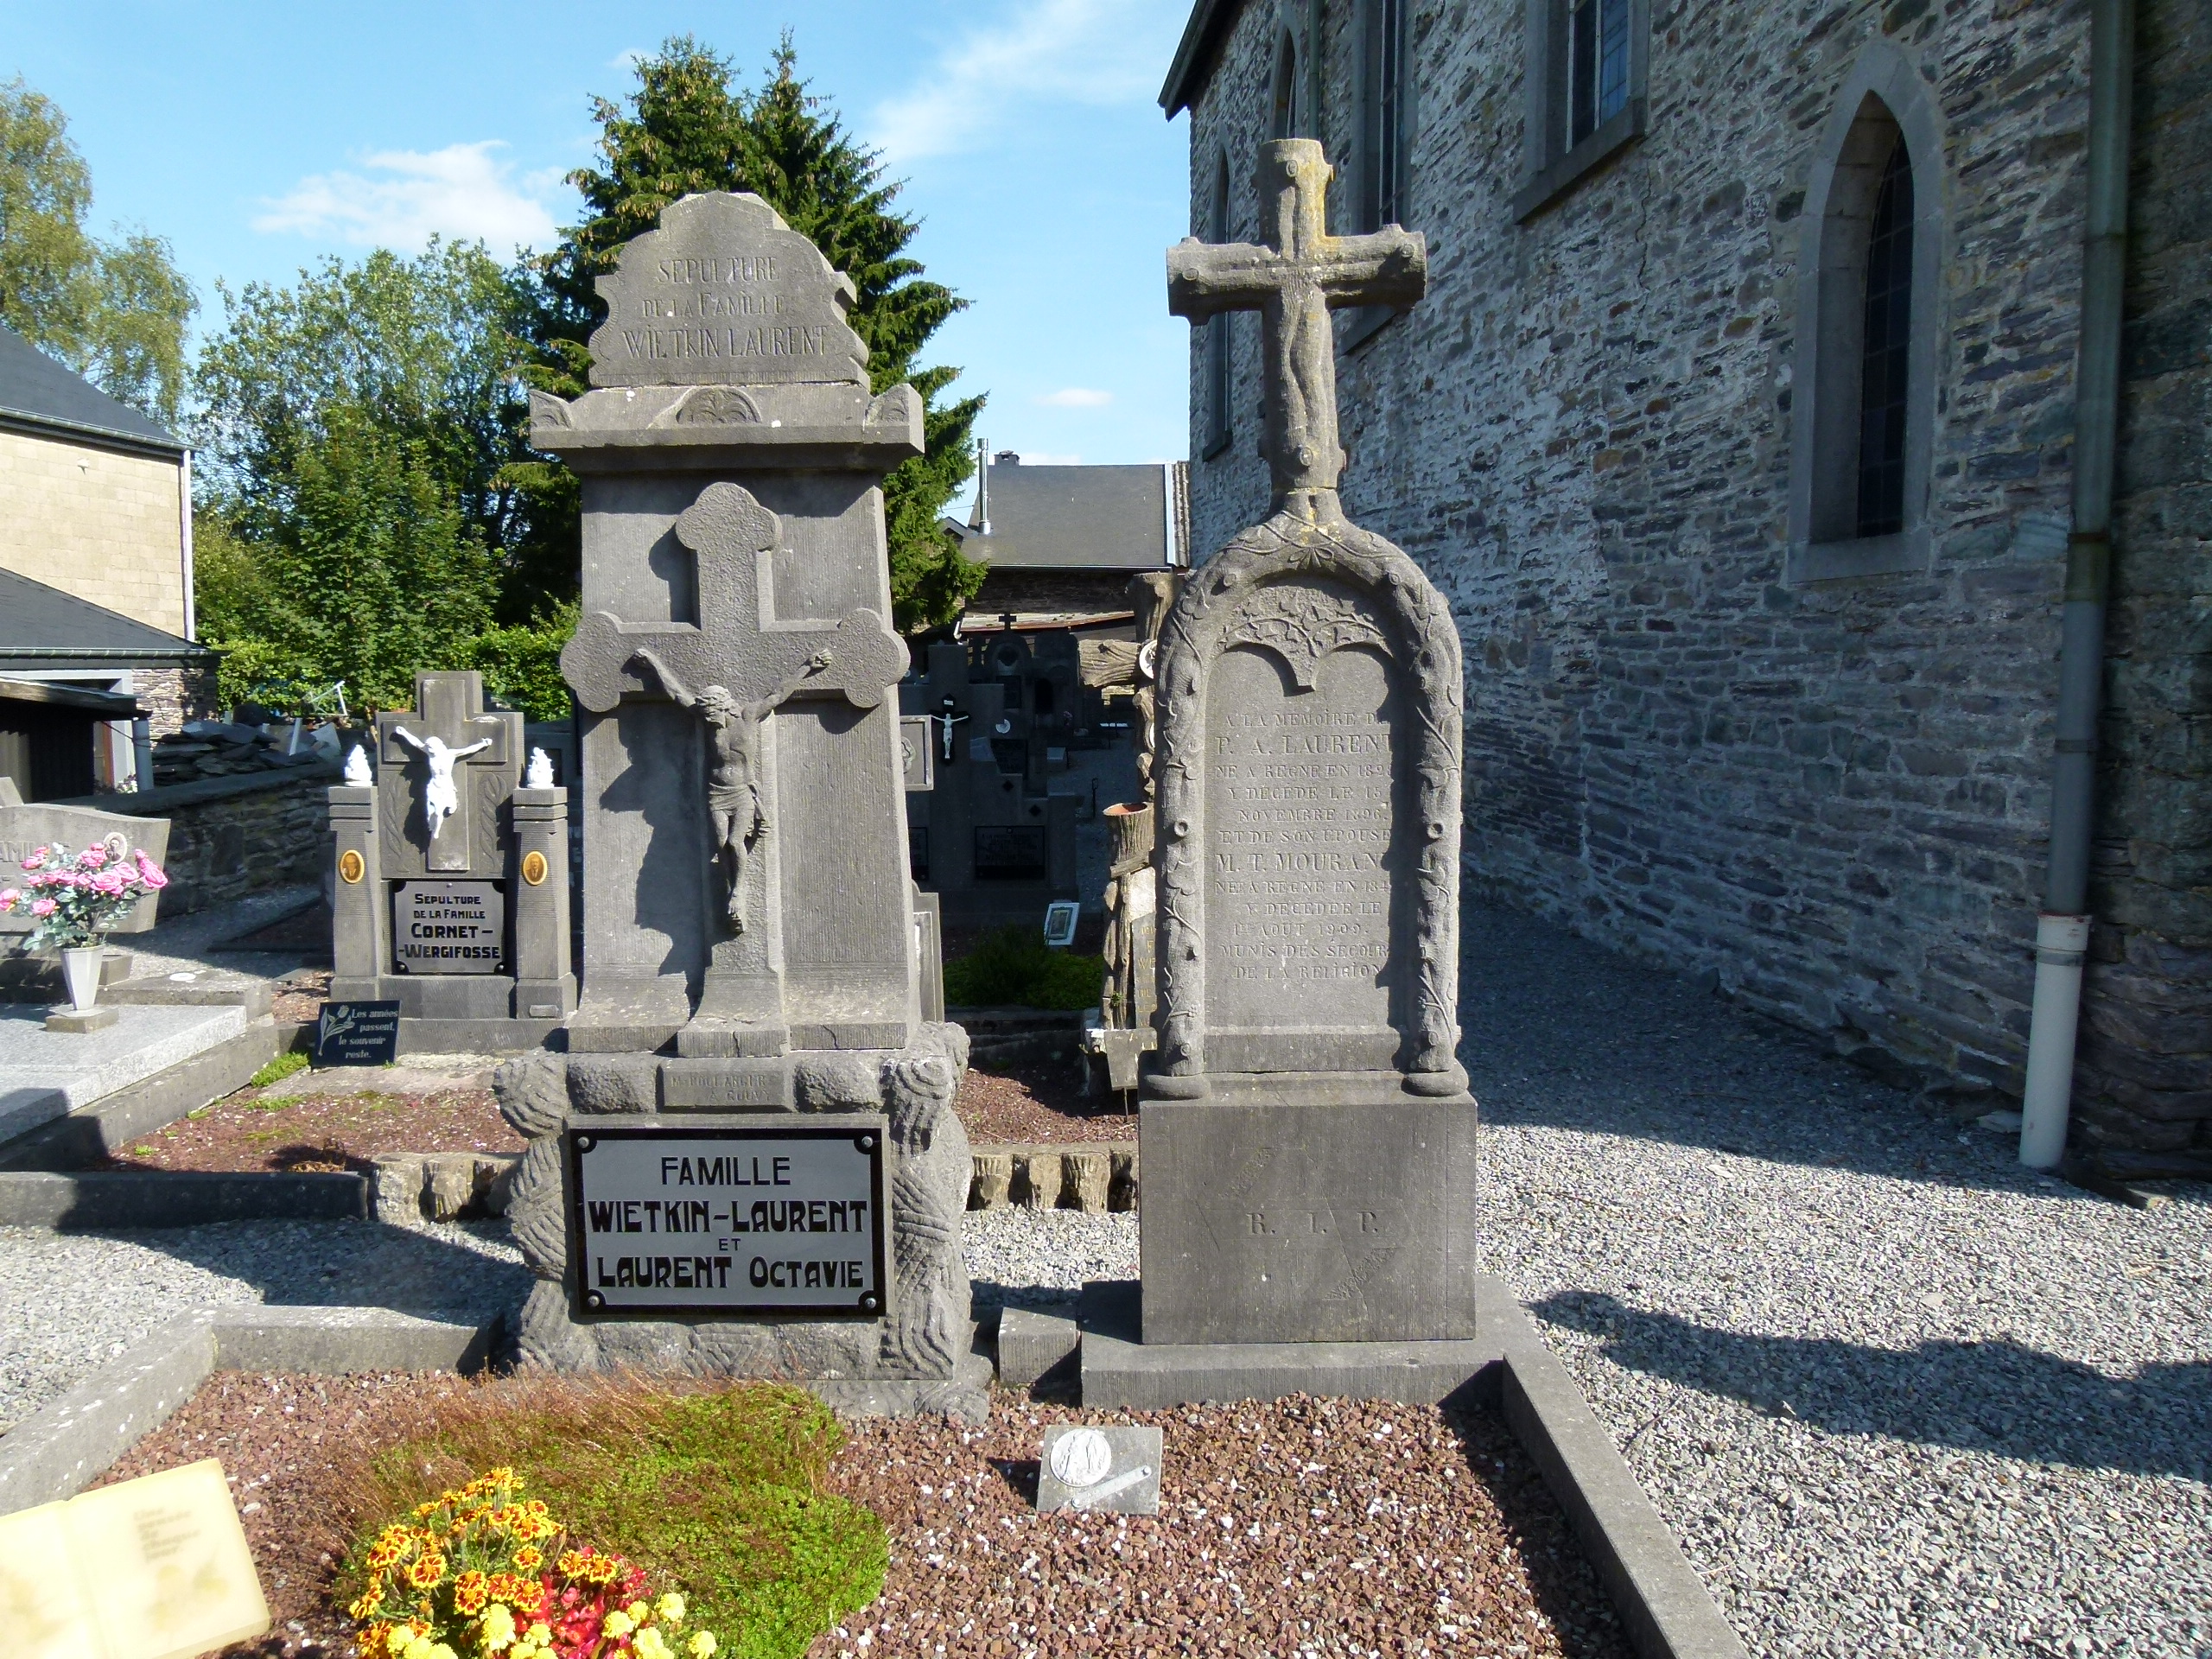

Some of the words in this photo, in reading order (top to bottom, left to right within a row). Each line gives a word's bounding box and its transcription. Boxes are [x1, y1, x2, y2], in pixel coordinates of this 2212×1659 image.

[698, 291, 785, 317] FAMILLE
[622, 325, 720, 359] WIETKIN
[728, 325, 828, 358] LAURENT
[1236, 808, 1336, 823] NOVEMBRE
[1280, 830, 1315, 843] SON
[1274, 852, 1387, 871] MOURAN
[413, 910, 426, 919] DE
[429, 910, 442, 919] LA
[444, 909, 486, 919] FAMILLE
[1325, 944, 1389, 958] SECOUR
[352, 1008, 367, 1019] Les
[338, 1035, 347, 1046] le
[349, 1036, 386, 1046] souvenir
[661, 1156, 791, 1185] FAMILLE
[1245, 1212, 1276, 1235] R.
[1357, 1211, 1378, 1234] P.
[718, 1237, 741, 1251] ET
[597, 1255, 733, 1287] LAURENT
[749, 1255, 863, 1287] OCTAVIE
